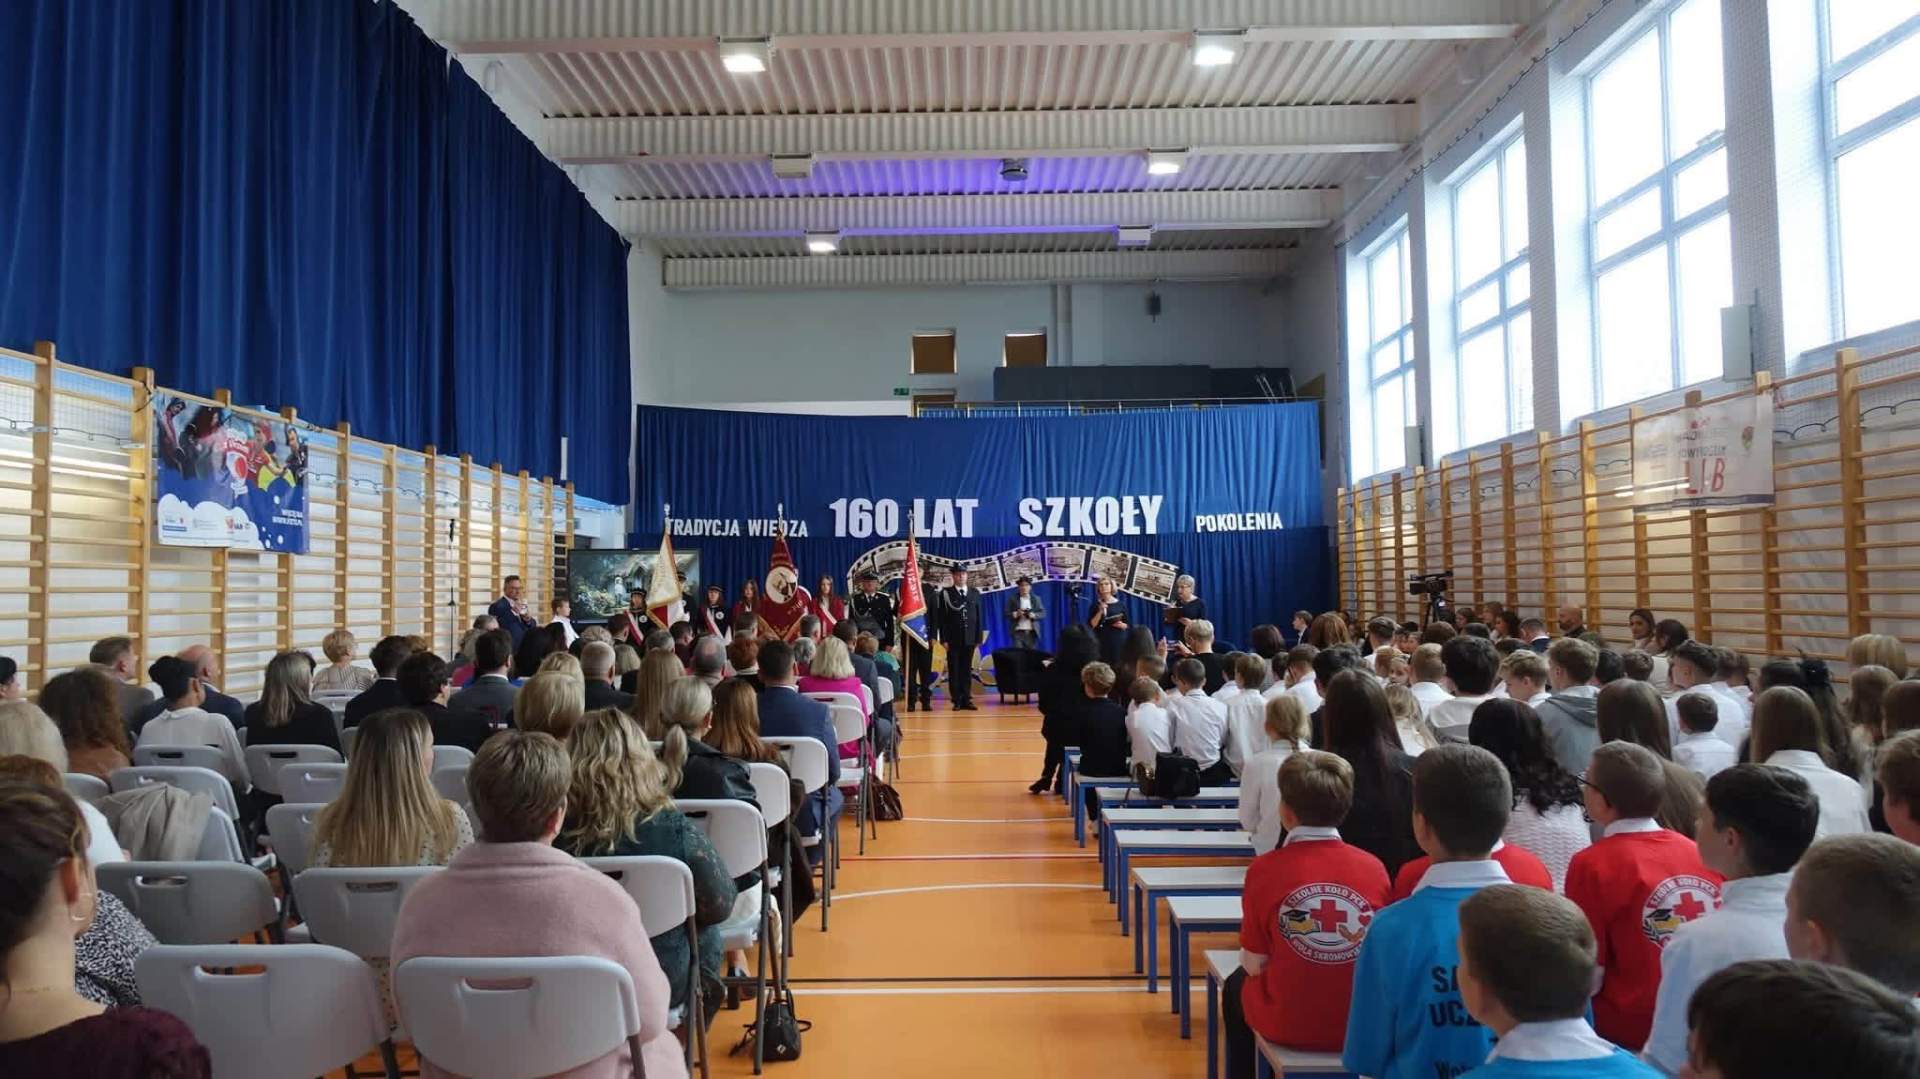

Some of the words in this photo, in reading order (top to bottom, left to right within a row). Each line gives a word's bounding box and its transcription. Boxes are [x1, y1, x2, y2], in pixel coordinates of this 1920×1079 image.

[829, 498, 899, 538] 160
[913, 498, 979, 538] LAT
[1018, 495, 1163, 537] SZKOŁY
[1195, 512, 1284, 533] POKOLENIA
